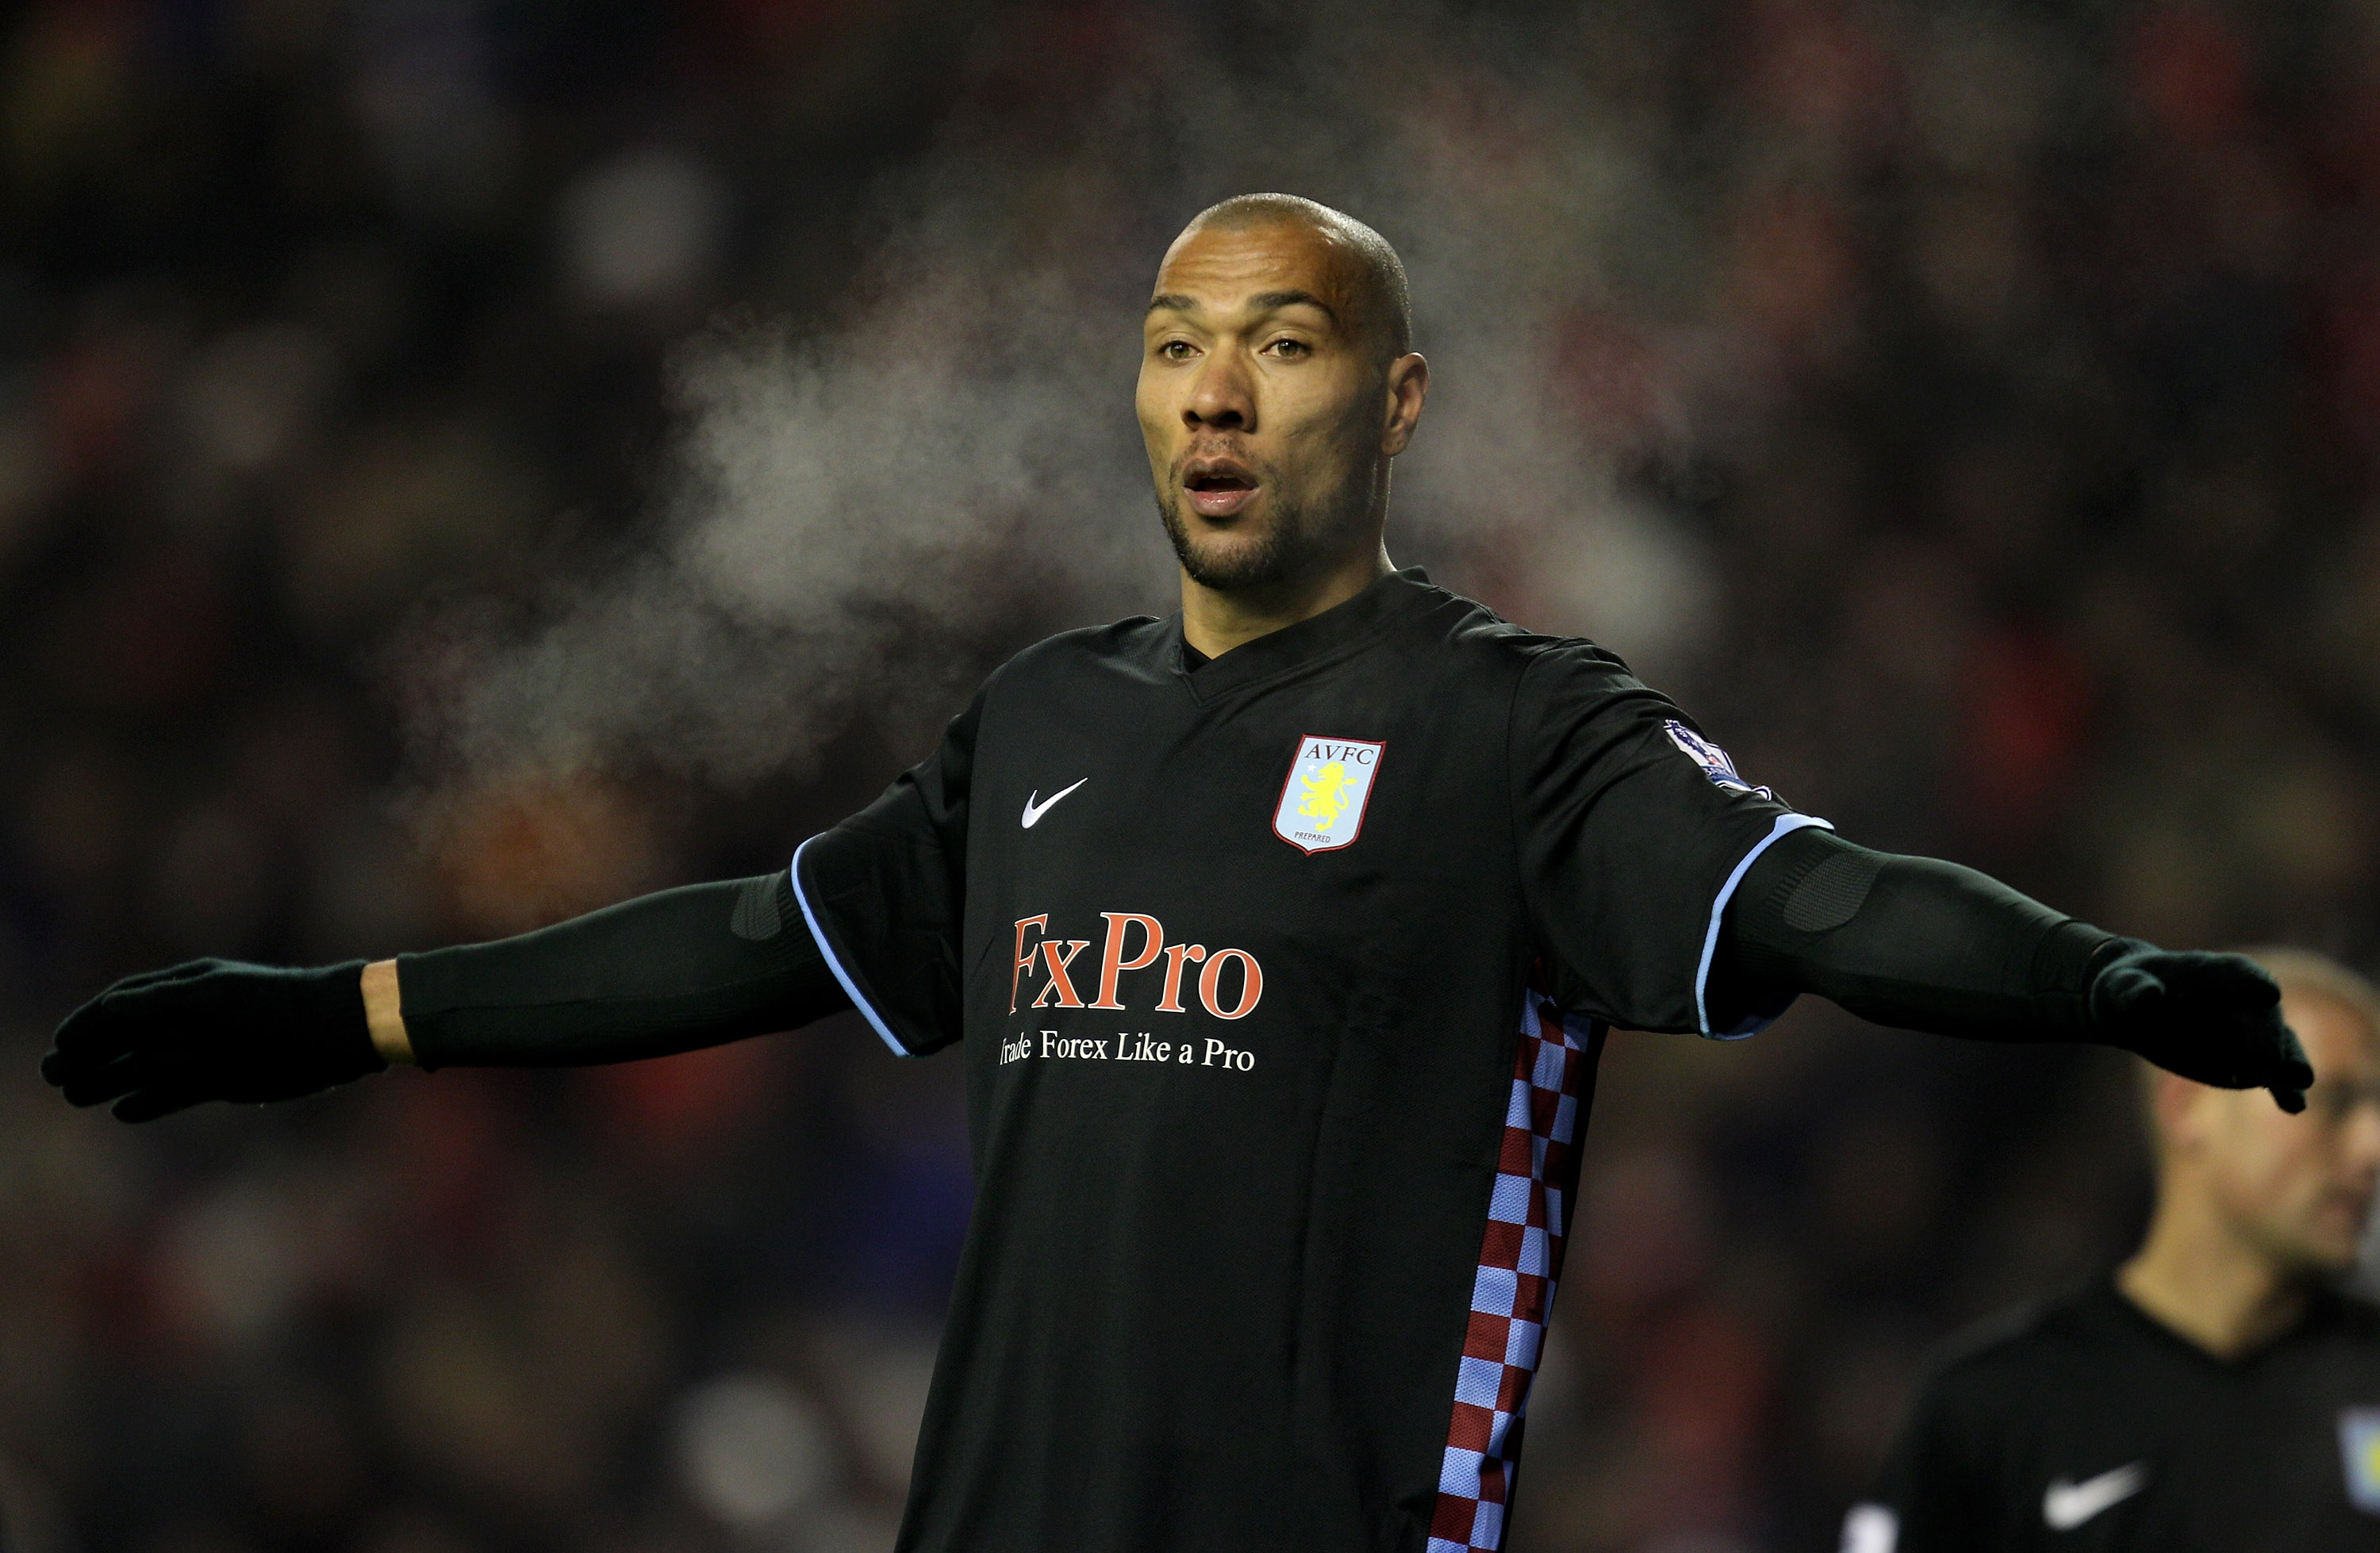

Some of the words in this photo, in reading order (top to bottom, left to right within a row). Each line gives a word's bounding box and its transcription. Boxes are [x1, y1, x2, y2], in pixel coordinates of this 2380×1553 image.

[1304, 743, 1374, 765] AVFC
[1294, 831, 1330, 843] PREPARED
[1008, 911, 1264, 1020] FxPro
[1039, 1030, 1108, 1060] Forex
[1115, 1032, 1171, 1062] Like
[1178, 1044, 1193, 1064] a
[1200, 1037, 1255, 1072] Pro
